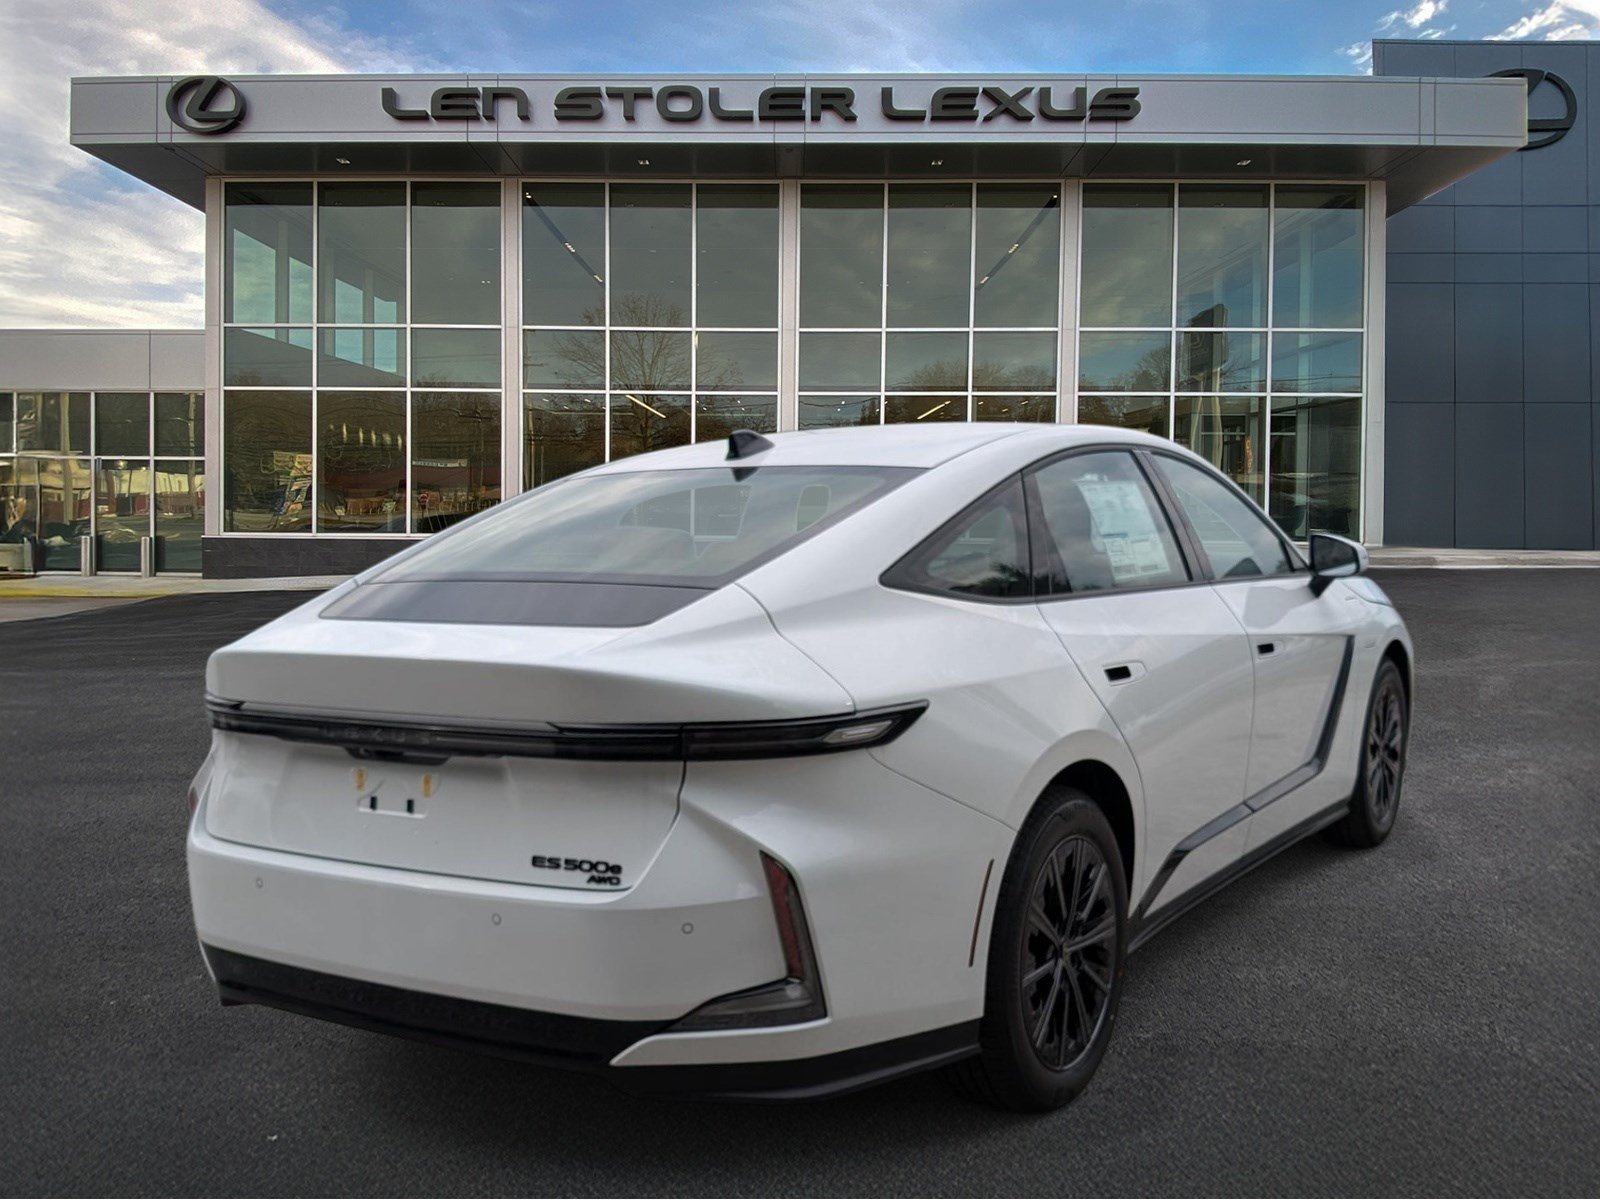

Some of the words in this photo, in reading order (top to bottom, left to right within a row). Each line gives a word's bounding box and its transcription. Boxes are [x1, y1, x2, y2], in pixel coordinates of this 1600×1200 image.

[381, 86, 530, 121] LEN
[553, 85, 857, 121] STOLER
[881, 86, 1141, 121] LEXUS
[532, 855, 561, 869] ES
[564, 858, 622, 875] 500e
[587, 875, 621, 886] AWD
